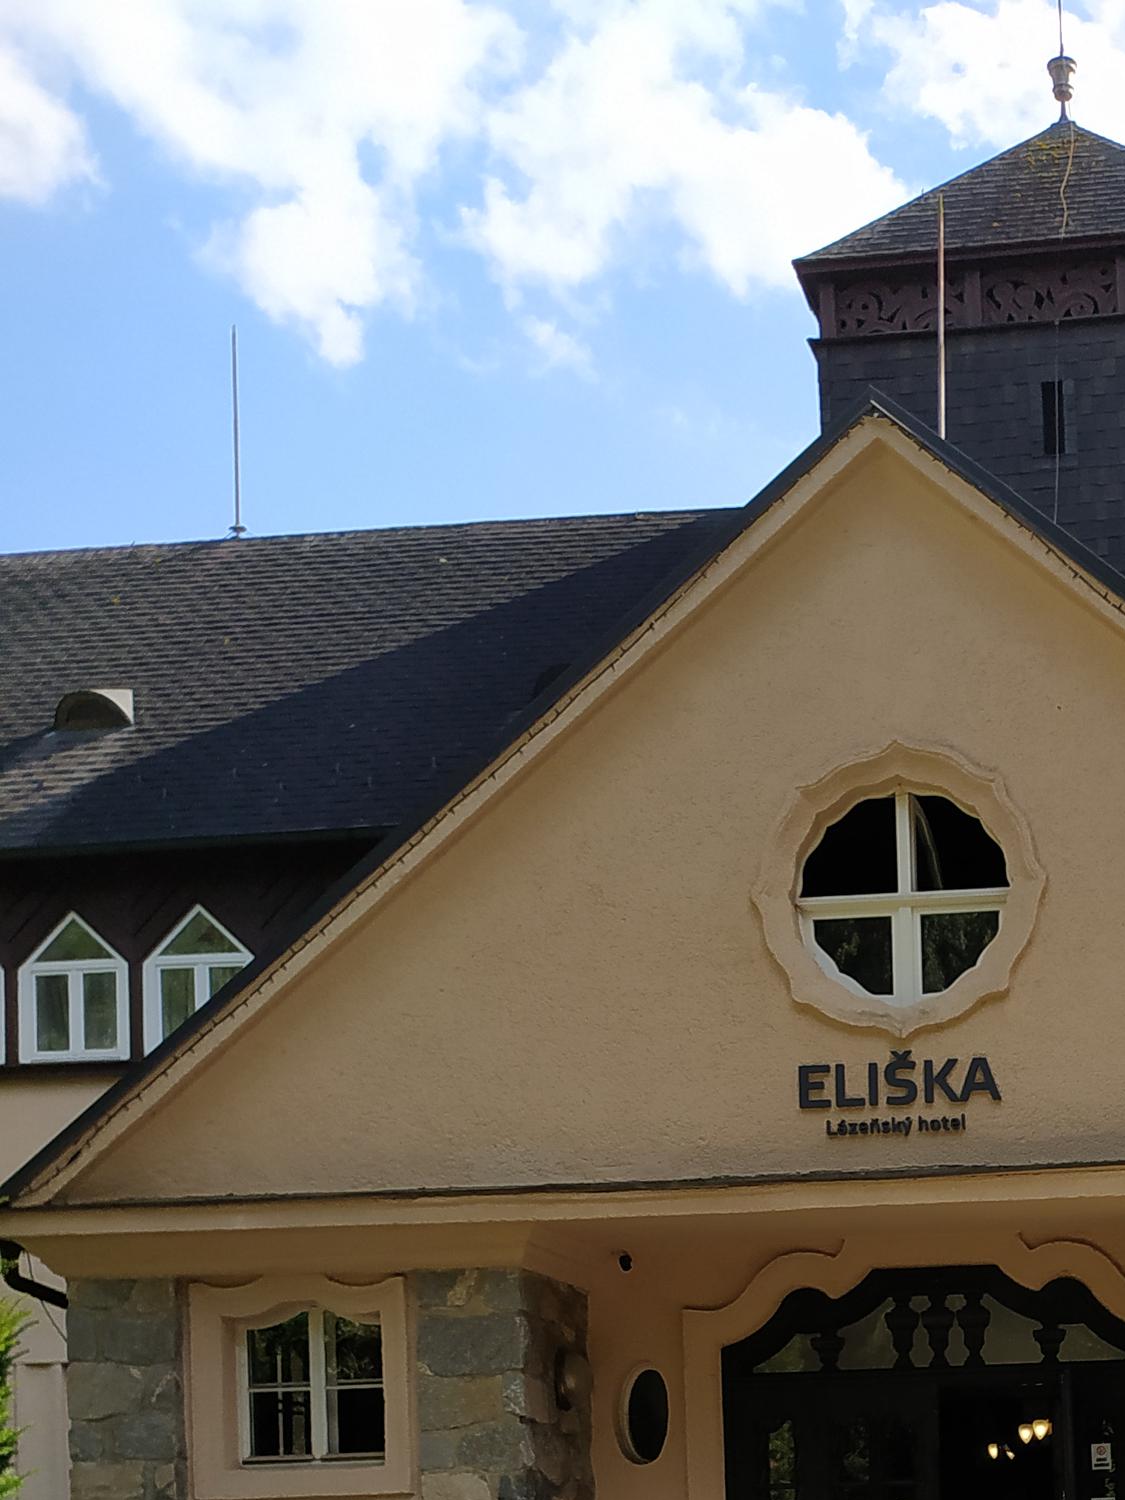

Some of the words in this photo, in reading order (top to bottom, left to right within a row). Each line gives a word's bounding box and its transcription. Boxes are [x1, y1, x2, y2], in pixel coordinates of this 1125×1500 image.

[798, 1050, 1002, 1109] ELIŠKA
[826, 1117, 913, 1136] Lázeňský
[918, 1113, 966, 1132] hotel
